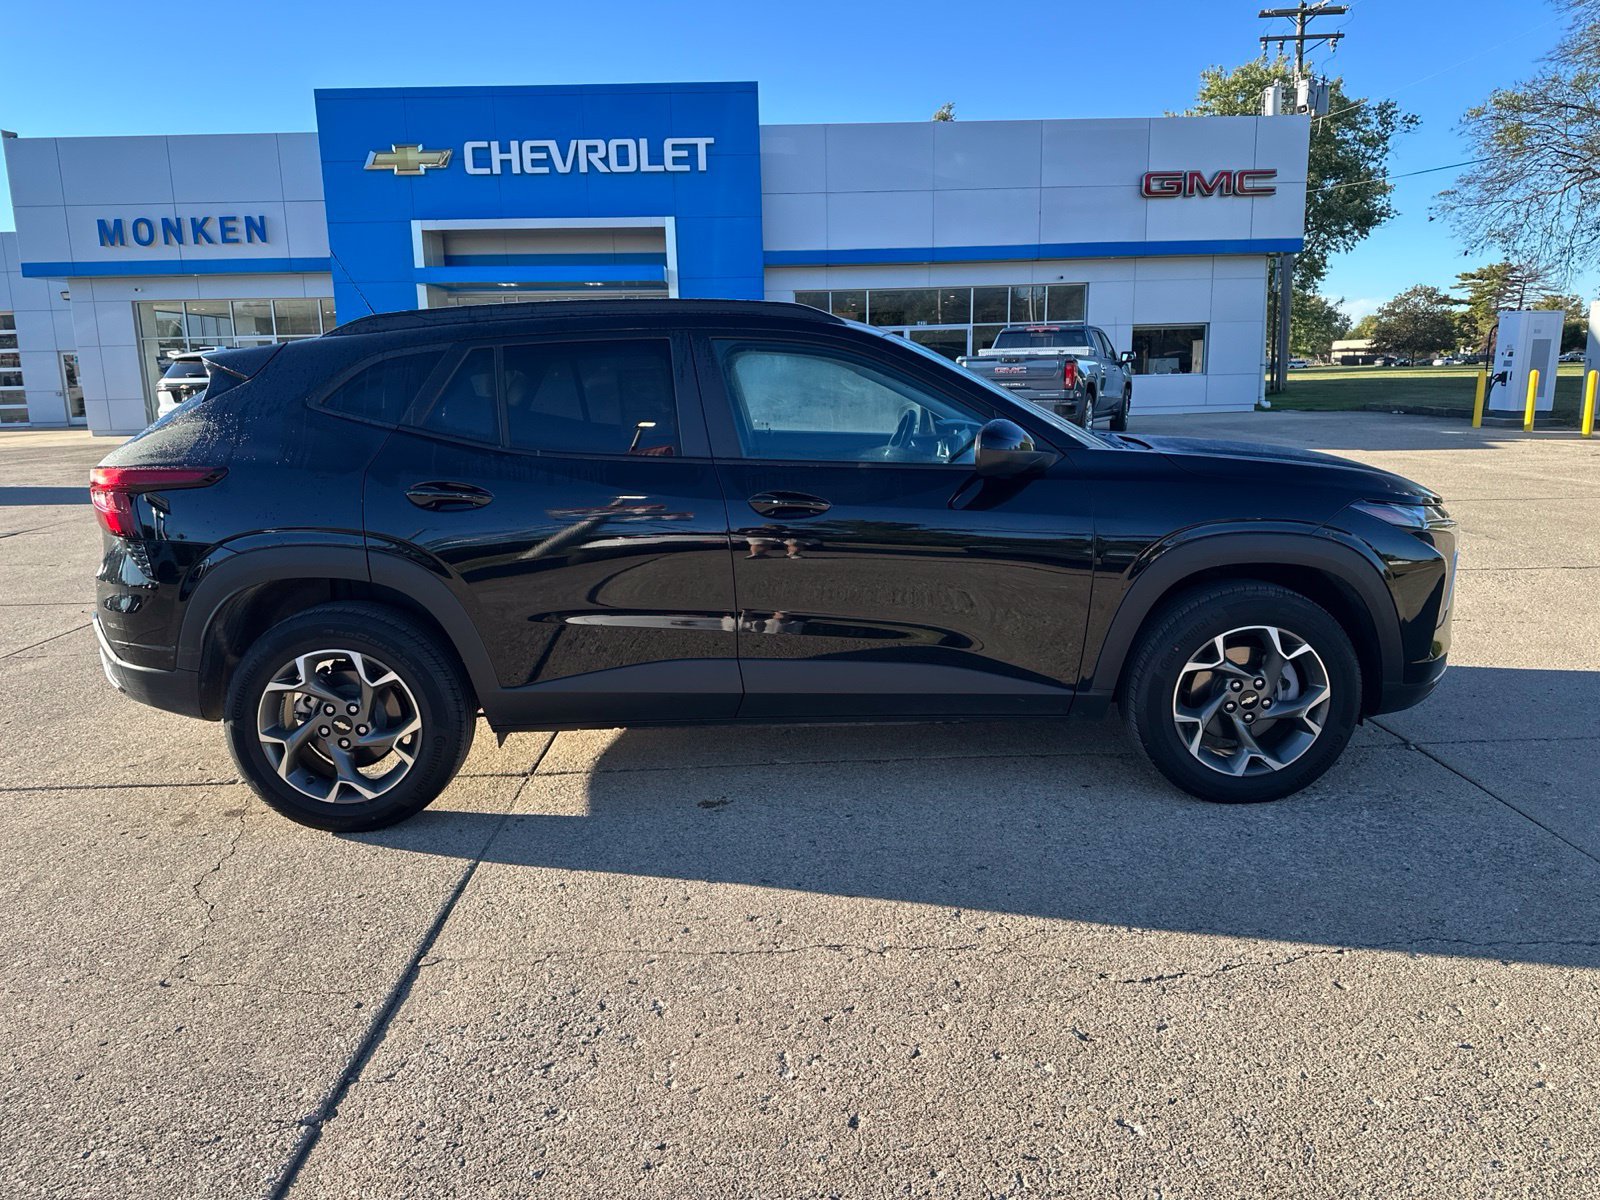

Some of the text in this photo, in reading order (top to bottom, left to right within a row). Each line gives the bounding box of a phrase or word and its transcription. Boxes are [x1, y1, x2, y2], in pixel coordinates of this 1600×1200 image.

[463, 137, 715, 175] CHEVROLET
[1140, 169, 1277, 198] GMC
[96, 215, 269, 247] MONKEN
[994, 366, 1027, 374] GMC
